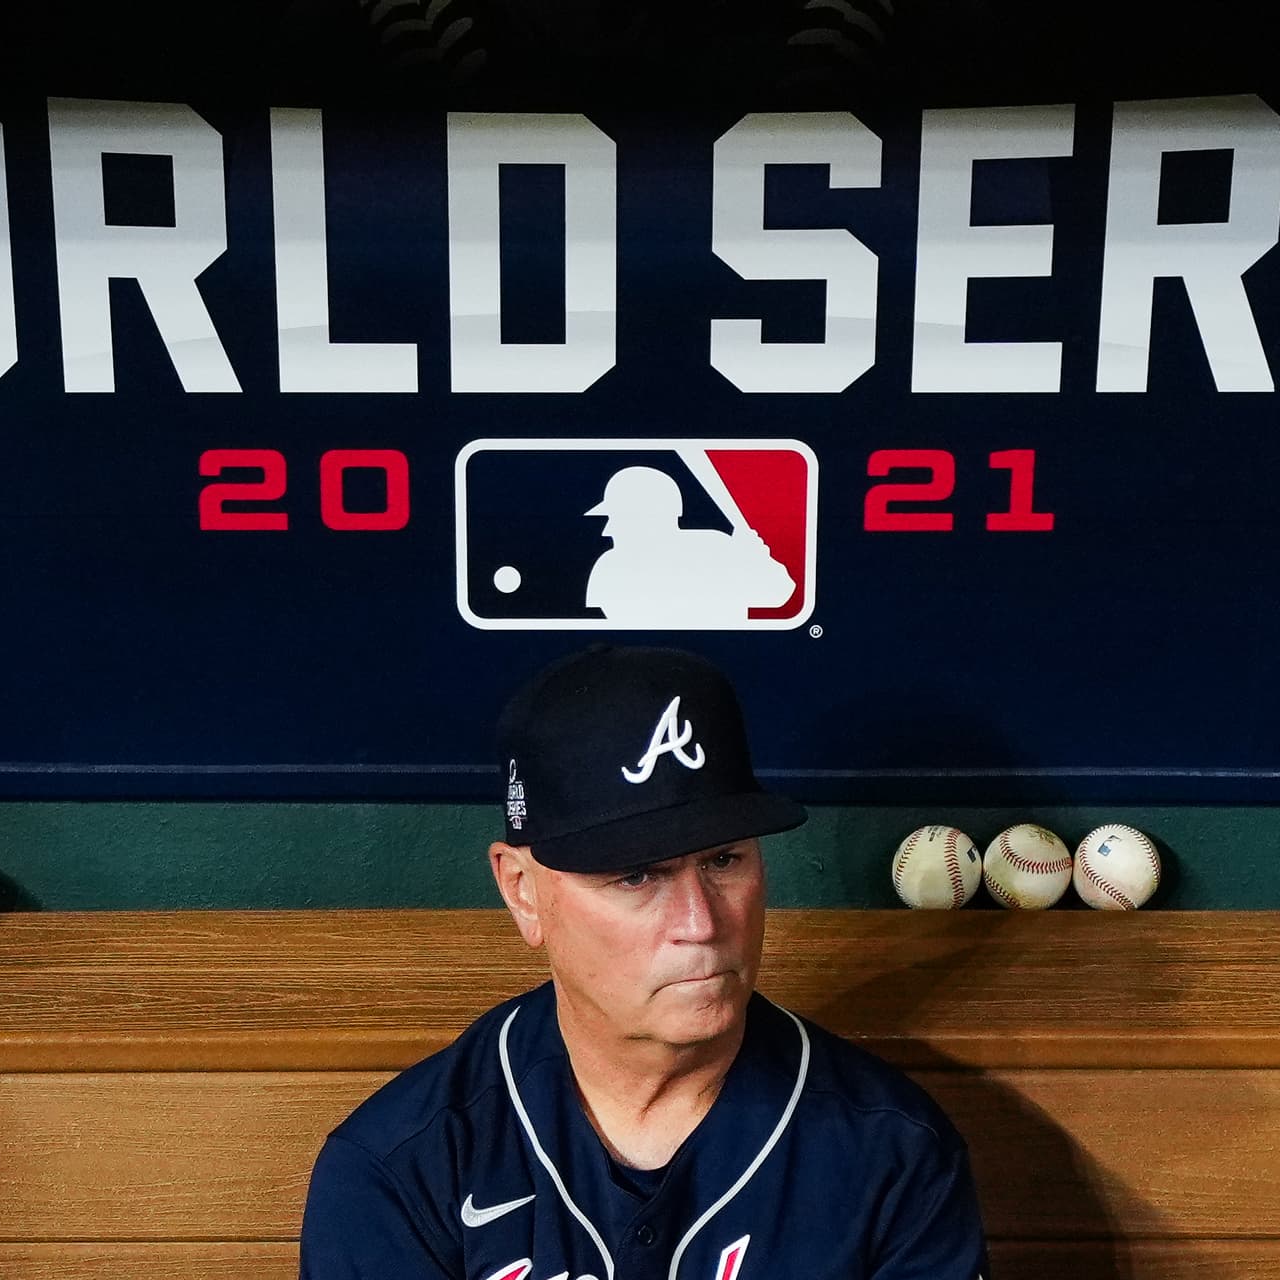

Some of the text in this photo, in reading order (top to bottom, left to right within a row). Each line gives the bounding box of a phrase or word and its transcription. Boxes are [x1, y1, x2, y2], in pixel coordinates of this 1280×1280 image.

[198, 447, 412, 532] 20
[862, 447, 1057, 532] 21
[621, 695, 707, 785] A
